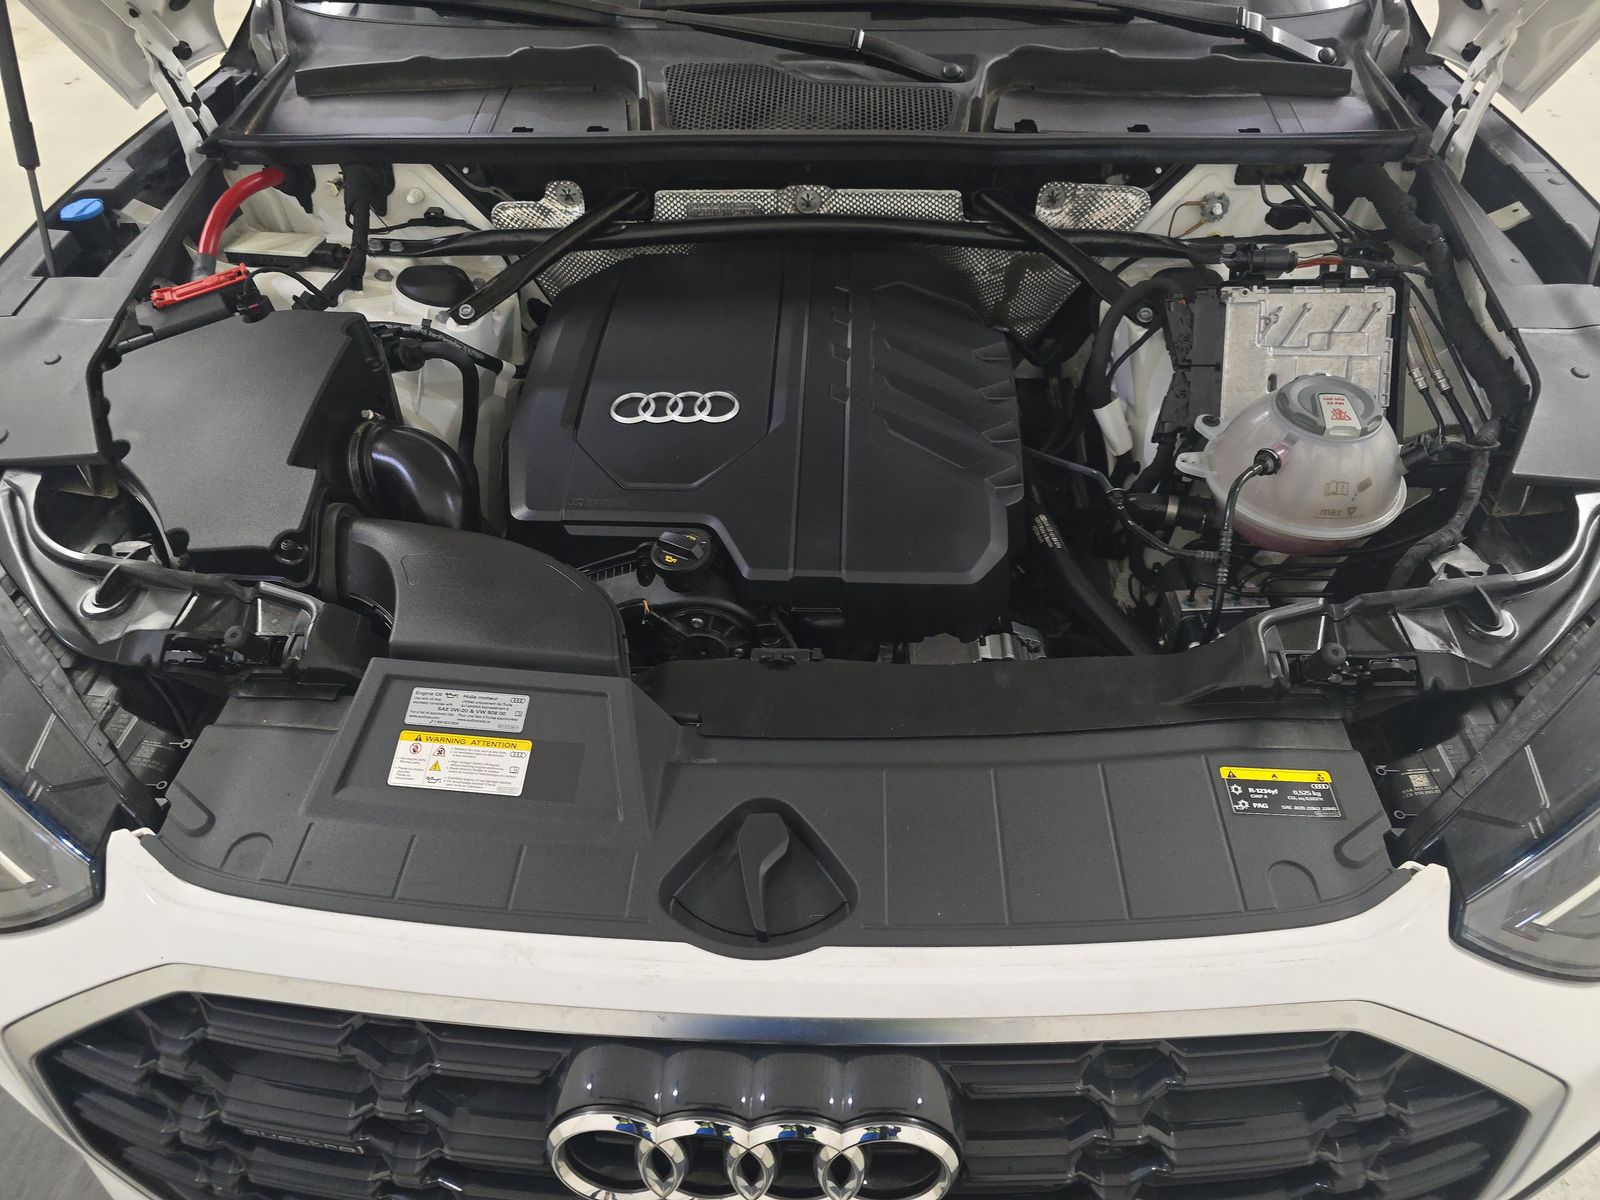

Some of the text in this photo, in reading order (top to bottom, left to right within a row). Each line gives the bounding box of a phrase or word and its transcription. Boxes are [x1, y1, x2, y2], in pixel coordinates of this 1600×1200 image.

[1320, 508, 1341, 516] max
[426, 736, 518, 749] WARNING ATTENTION
